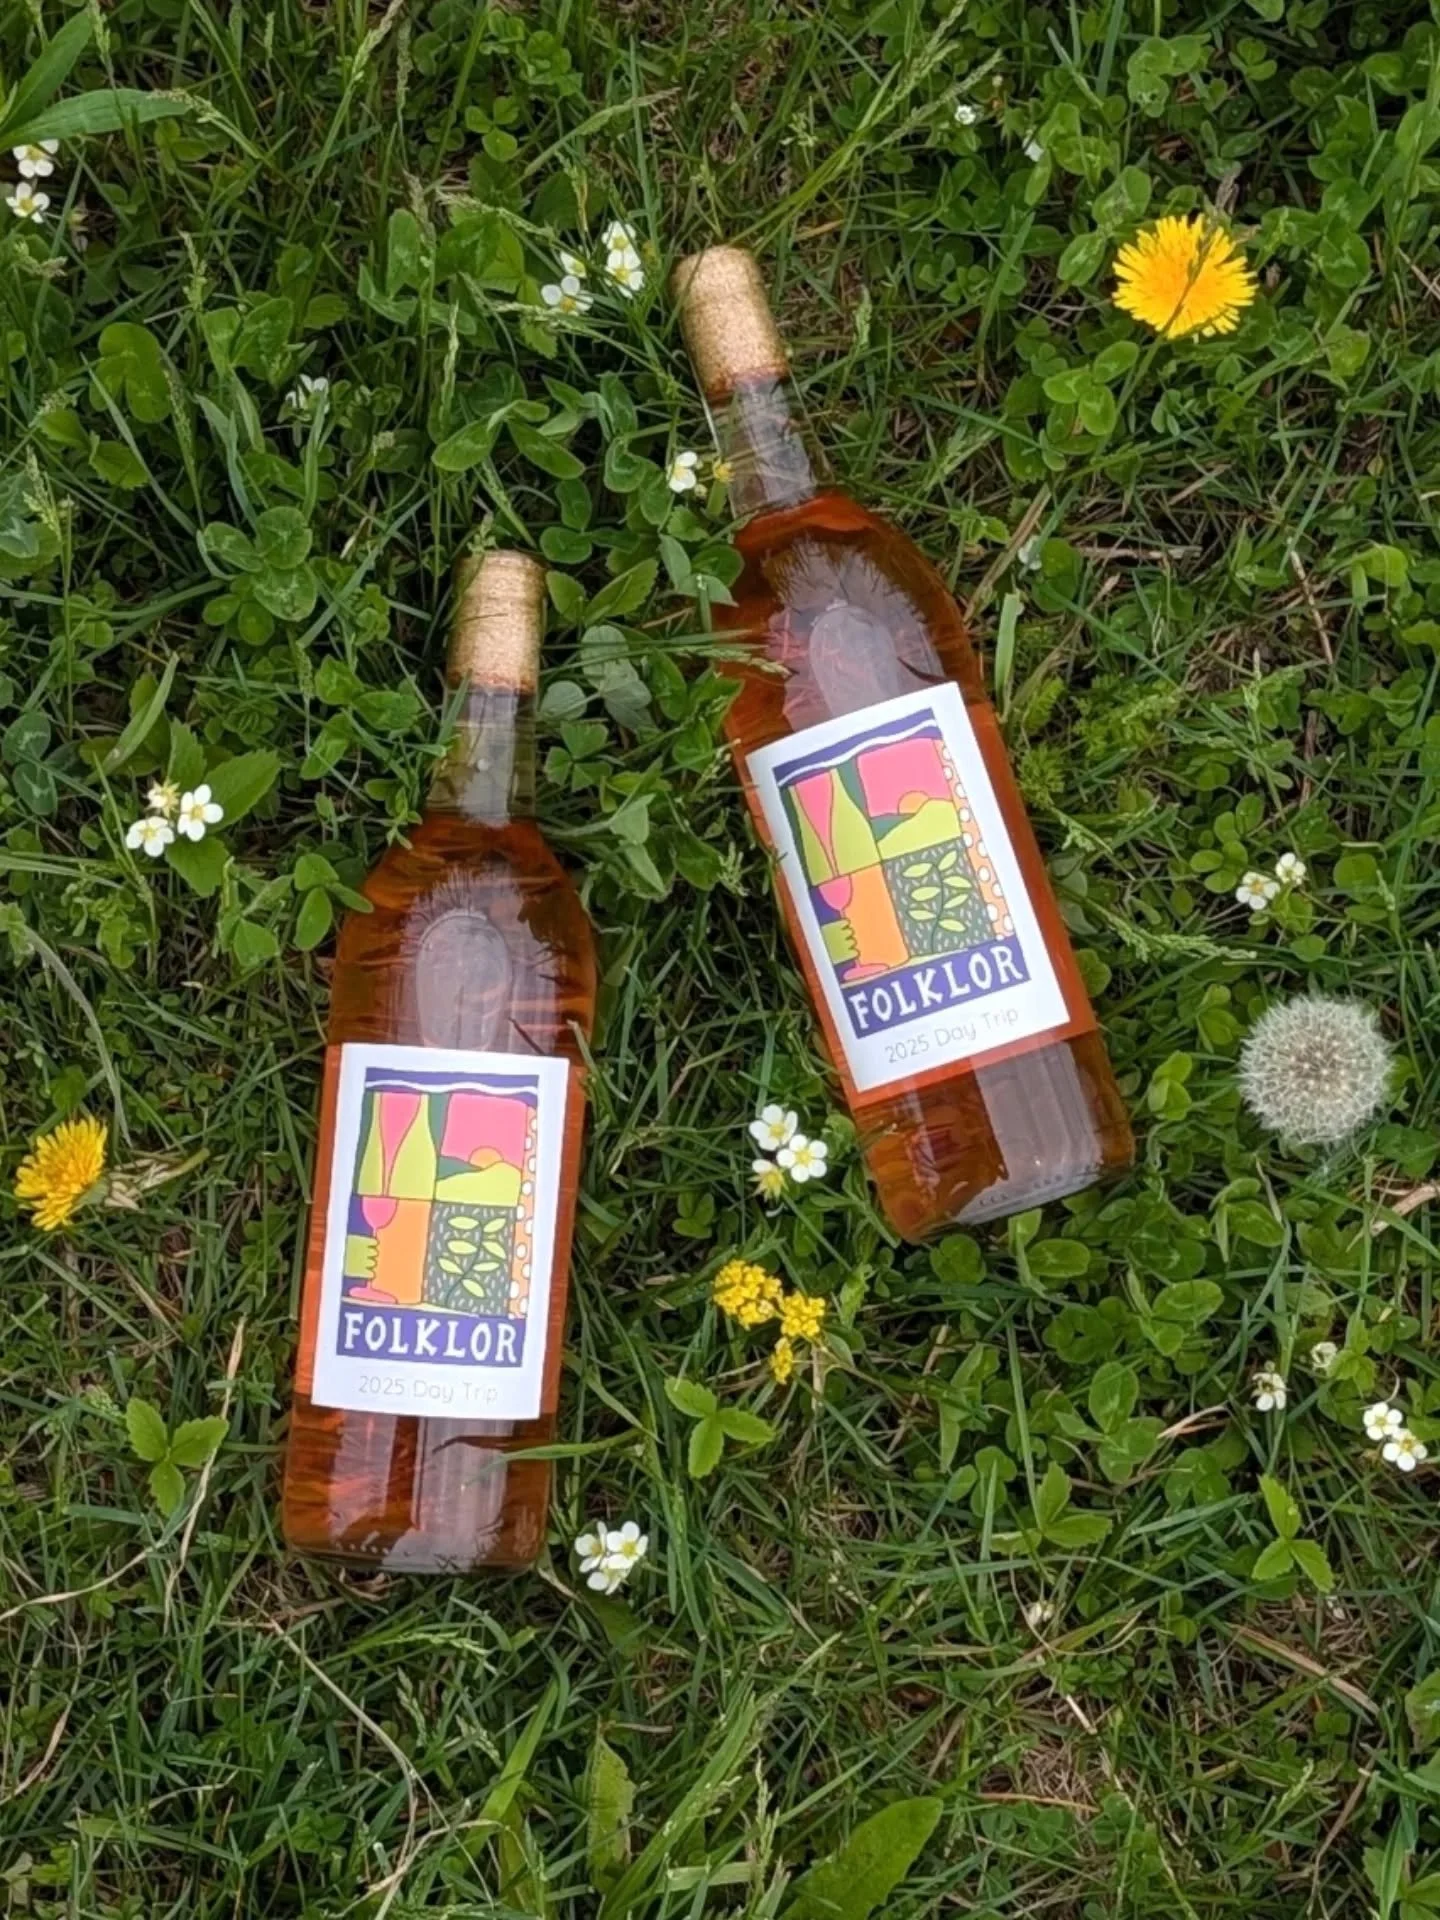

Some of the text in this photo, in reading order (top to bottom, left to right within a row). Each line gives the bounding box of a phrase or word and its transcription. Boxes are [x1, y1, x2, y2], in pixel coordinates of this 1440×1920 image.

[849, 945, 1024, 1029] FOLKLOR
[885, 1008, 1018, 1063] 2025 Day Trip
[344, 1312, 516, 1363] FOLKLOR
[358, 1375, 498, 1403] 2025 Day Trip
